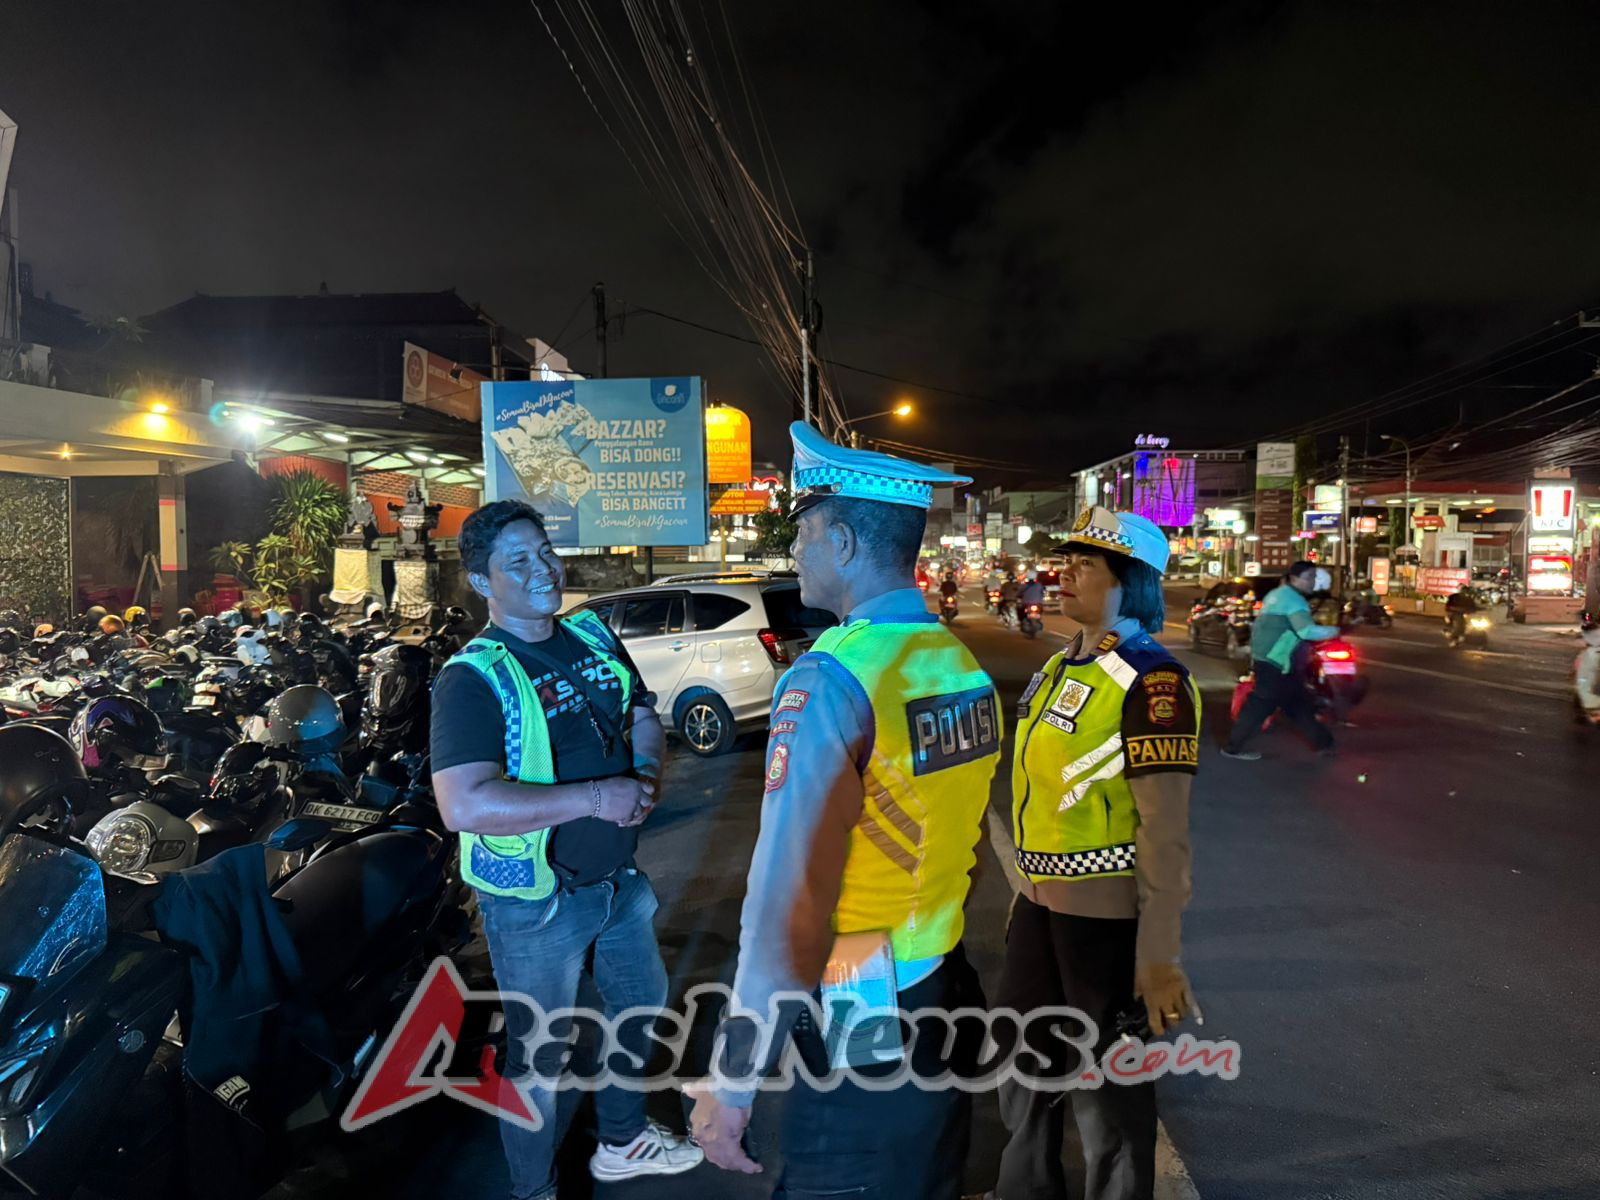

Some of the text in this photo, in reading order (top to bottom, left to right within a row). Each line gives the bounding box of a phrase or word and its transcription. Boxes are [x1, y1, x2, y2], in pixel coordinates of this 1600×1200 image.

[586, 419, 667, 439] BAZZAR?
[600, 447, 681, 463] BISA DONG!!
[586, 471, 687, 490] RESERVASI?
[601, 497, 687, 511] BISA BANGETT
[915, 697, 997, 761] POLISI
[1044, 713, 1071, 730] POLRI
